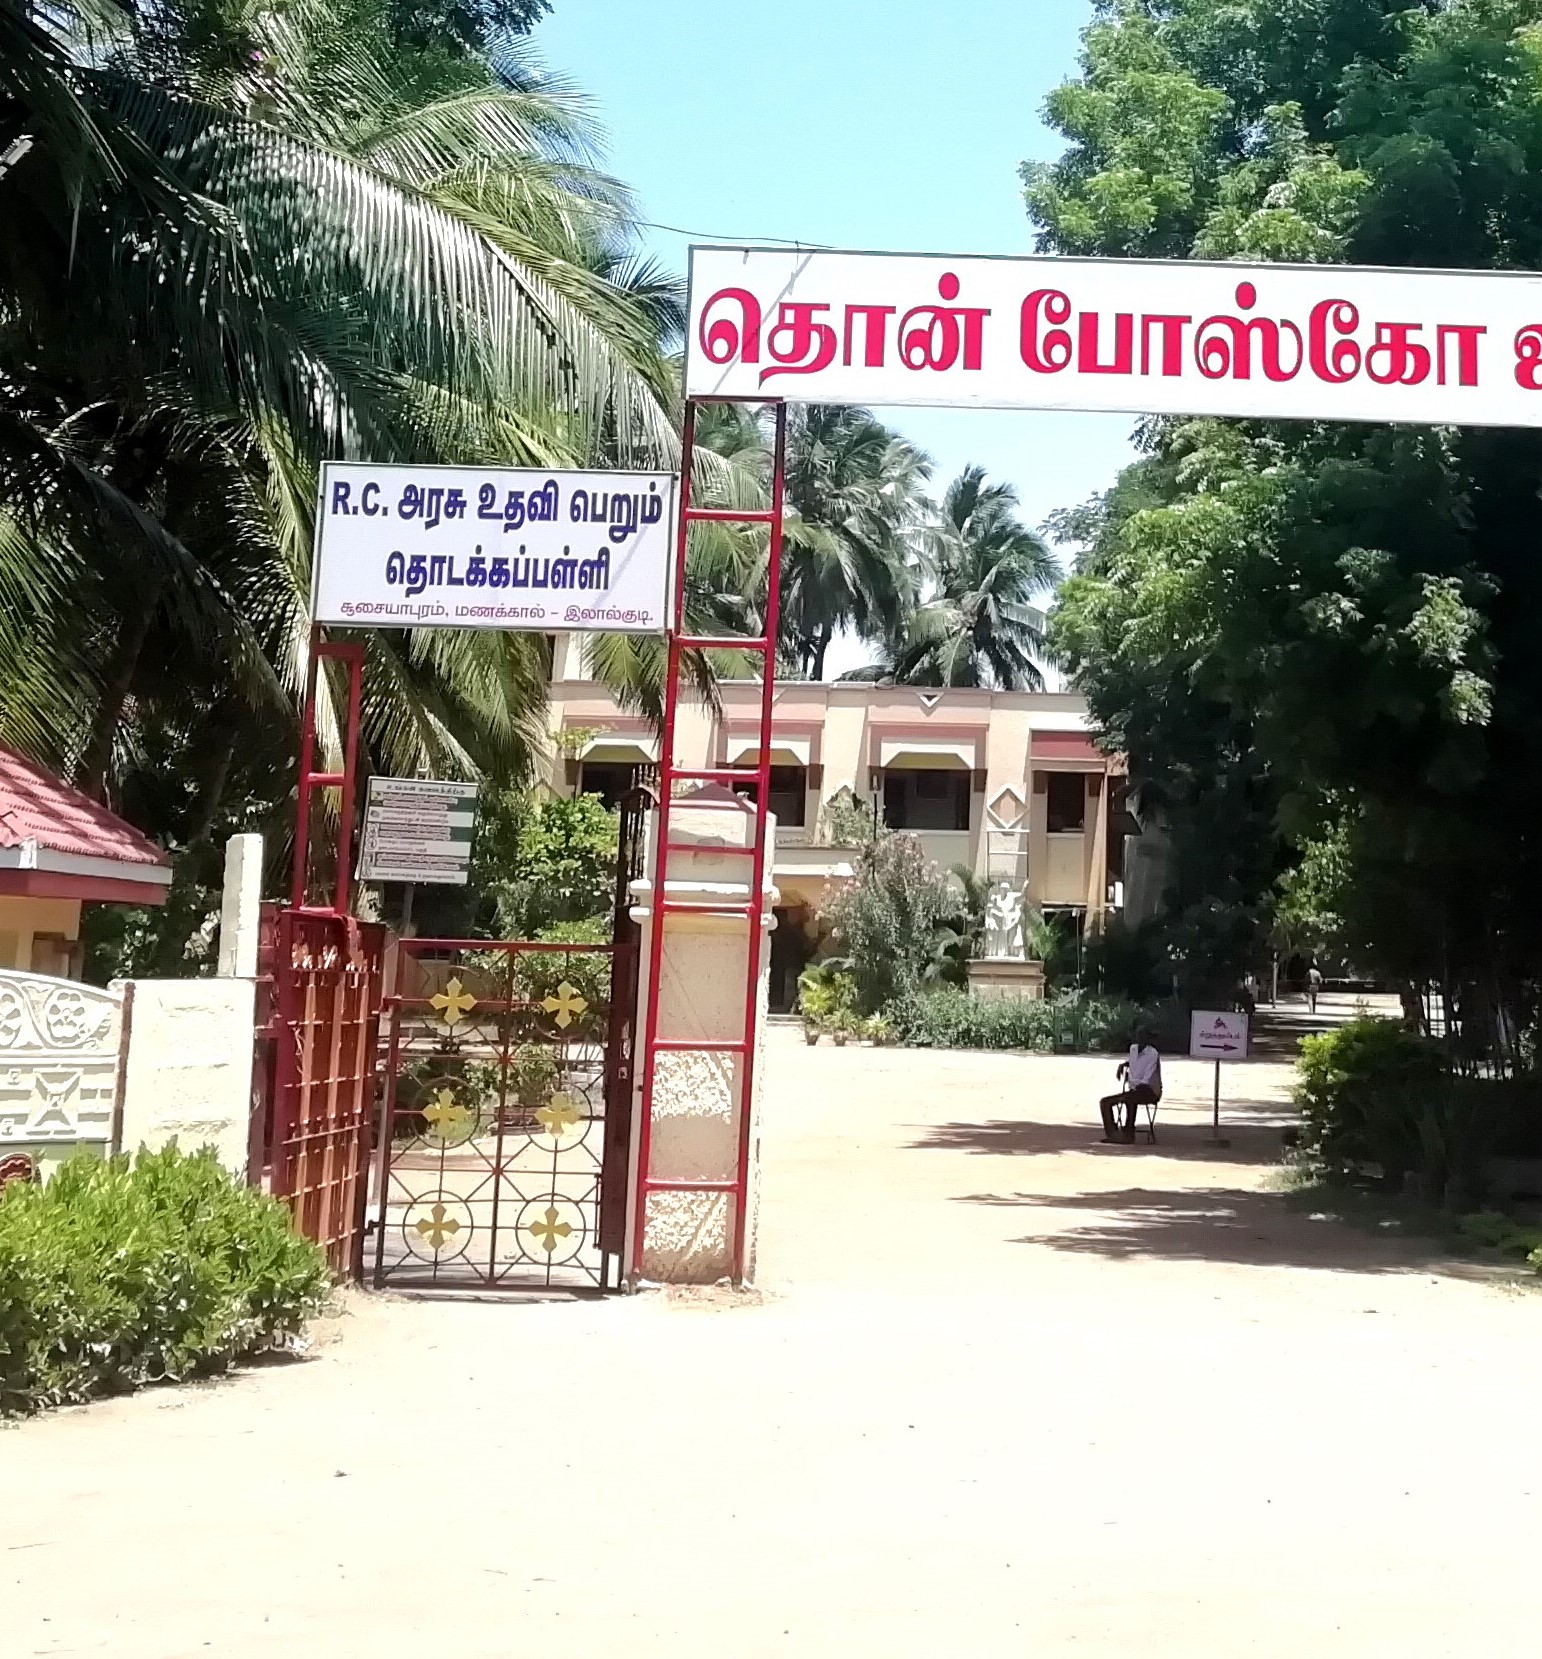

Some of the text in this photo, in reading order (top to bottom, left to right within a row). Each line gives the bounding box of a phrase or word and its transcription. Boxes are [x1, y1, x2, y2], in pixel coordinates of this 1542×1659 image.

[699, 271, 992, 390] தொன்
[1020, 281, 1488, 388] போஸ்கோ
[331, 479, 663, 544] R.C. அரசு உதவி பெறும்
[385, 544, 611, 598] தொடக்கப்பள்ளி
[340, 600, 450, 621] சூசையாபுரம்,
[455, 602, 545, 620] மணக்கால்
[563, 604, 654, 625] இலால்குடி.
